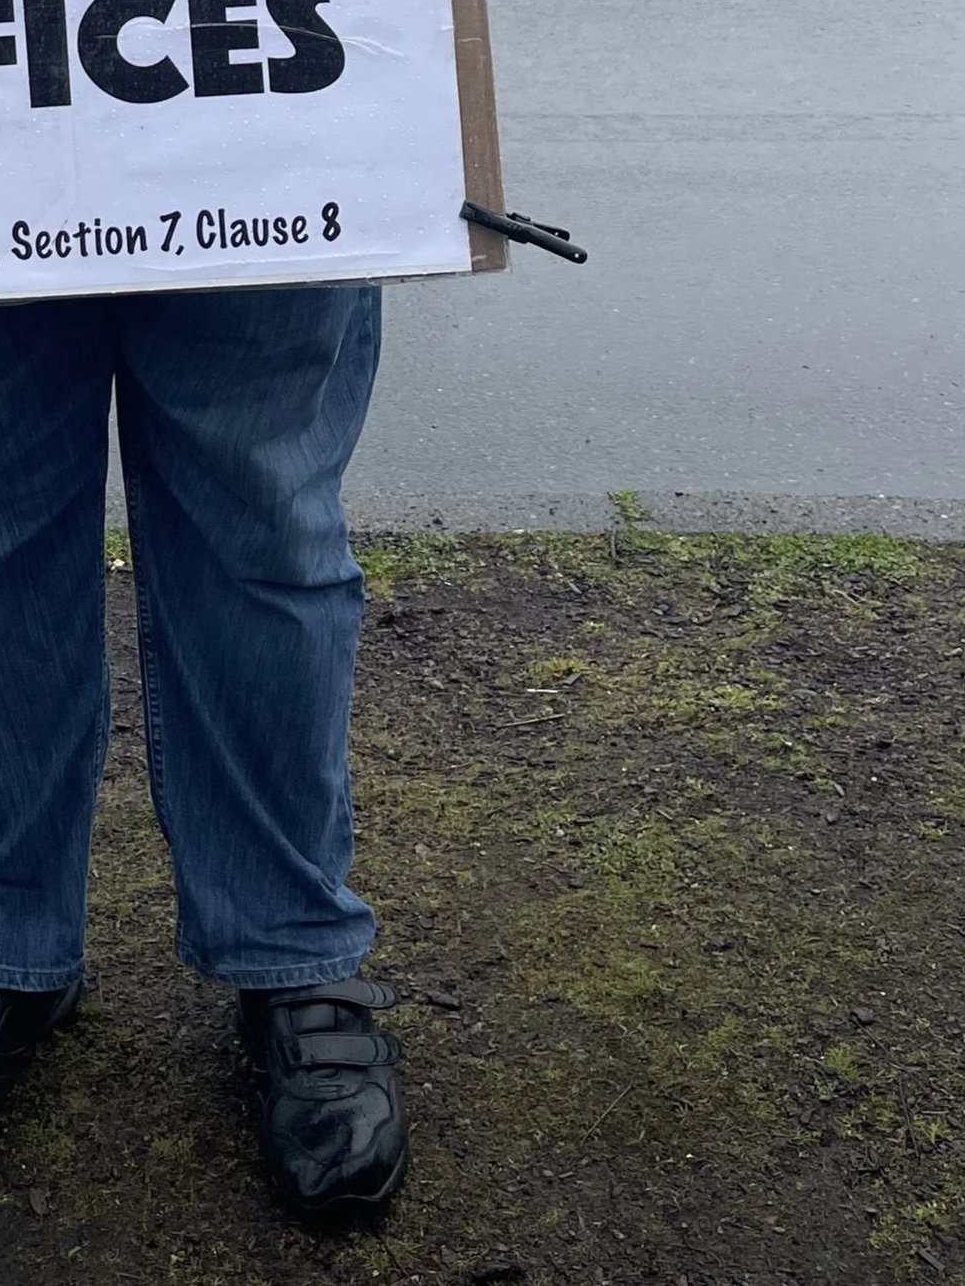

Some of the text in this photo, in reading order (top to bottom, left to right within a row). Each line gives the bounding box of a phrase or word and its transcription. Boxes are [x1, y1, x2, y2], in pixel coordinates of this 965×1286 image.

[11, 220, 149, 260] Section
[159, 211, 184, 257] 7,
[196, 209, 310, 250] Clause
[321, 201, 342, 243] 8
